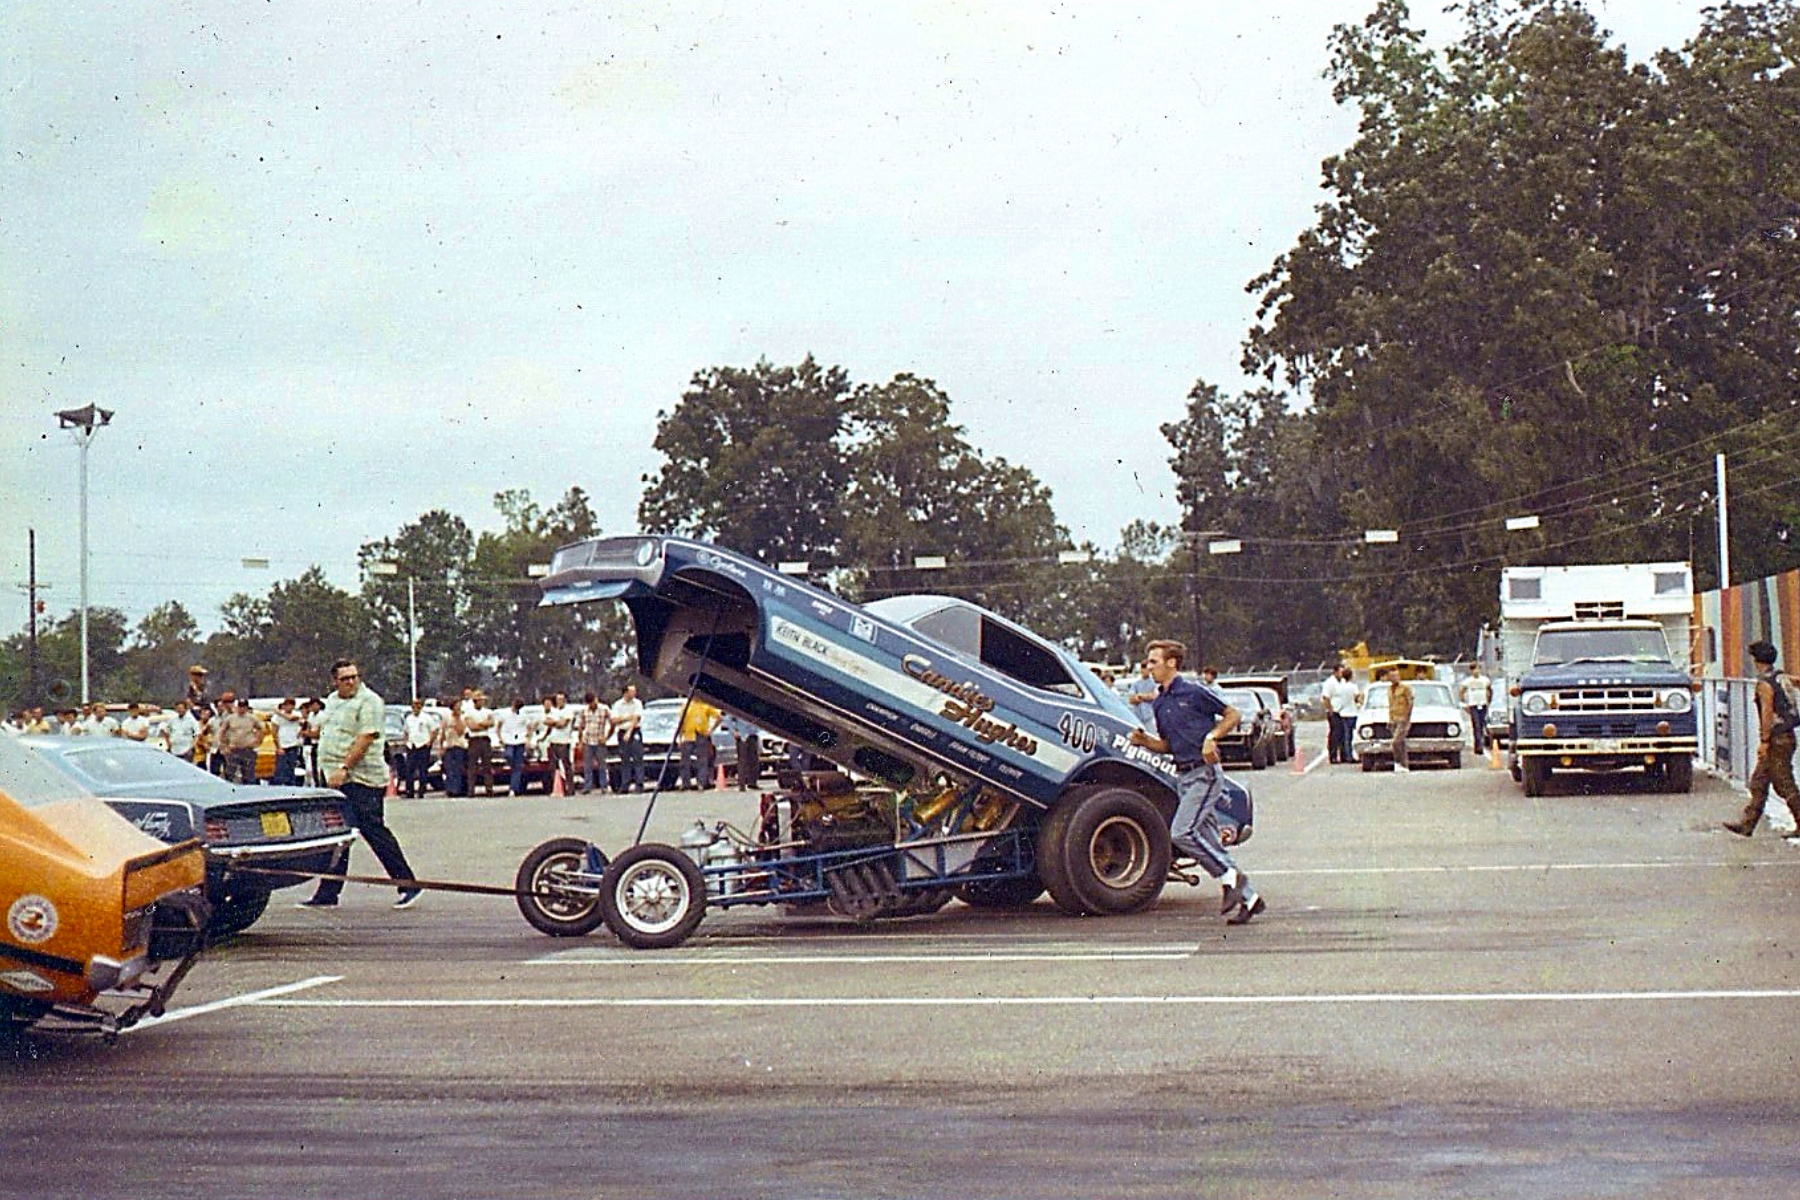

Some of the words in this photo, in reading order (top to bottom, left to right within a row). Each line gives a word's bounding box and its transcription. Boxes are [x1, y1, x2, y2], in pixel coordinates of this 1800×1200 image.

[901, 654, 994, 712] Candies
[939, 699, 1037, 755] Hughes
[1058, 711, 1096, 755] 400
[1111, 733, 1180, 778] Plymout
